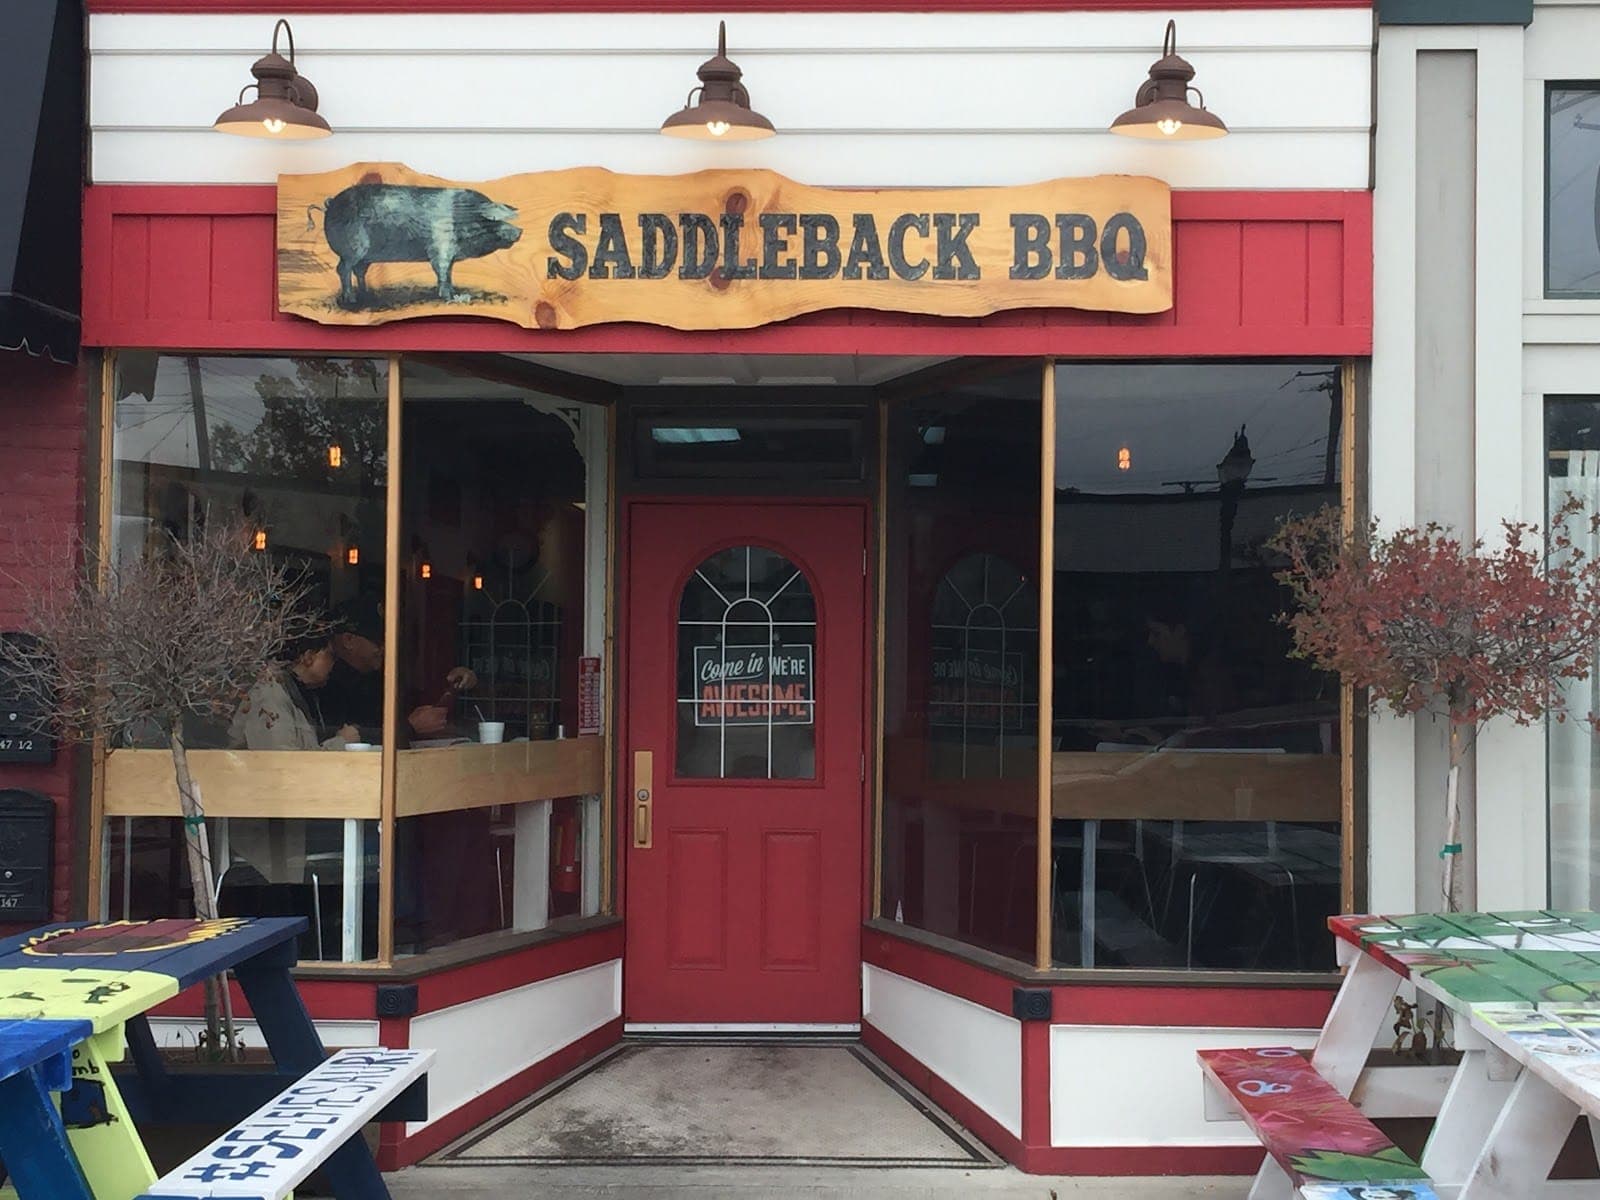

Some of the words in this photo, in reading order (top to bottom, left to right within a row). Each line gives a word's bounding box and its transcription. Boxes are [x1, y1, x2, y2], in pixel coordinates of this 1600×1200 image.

[546, 212, 981, 281] SADDLEBACK
[1009, 212, 1149, 282] BBQ
[701, 659, 744, 681] Come
[746, 652, 764, 673] in
[768, 655, 806, 676] WE'RE
[701, 683, 807, 718] AWESOME
[0, 898, 18, 908] 147
